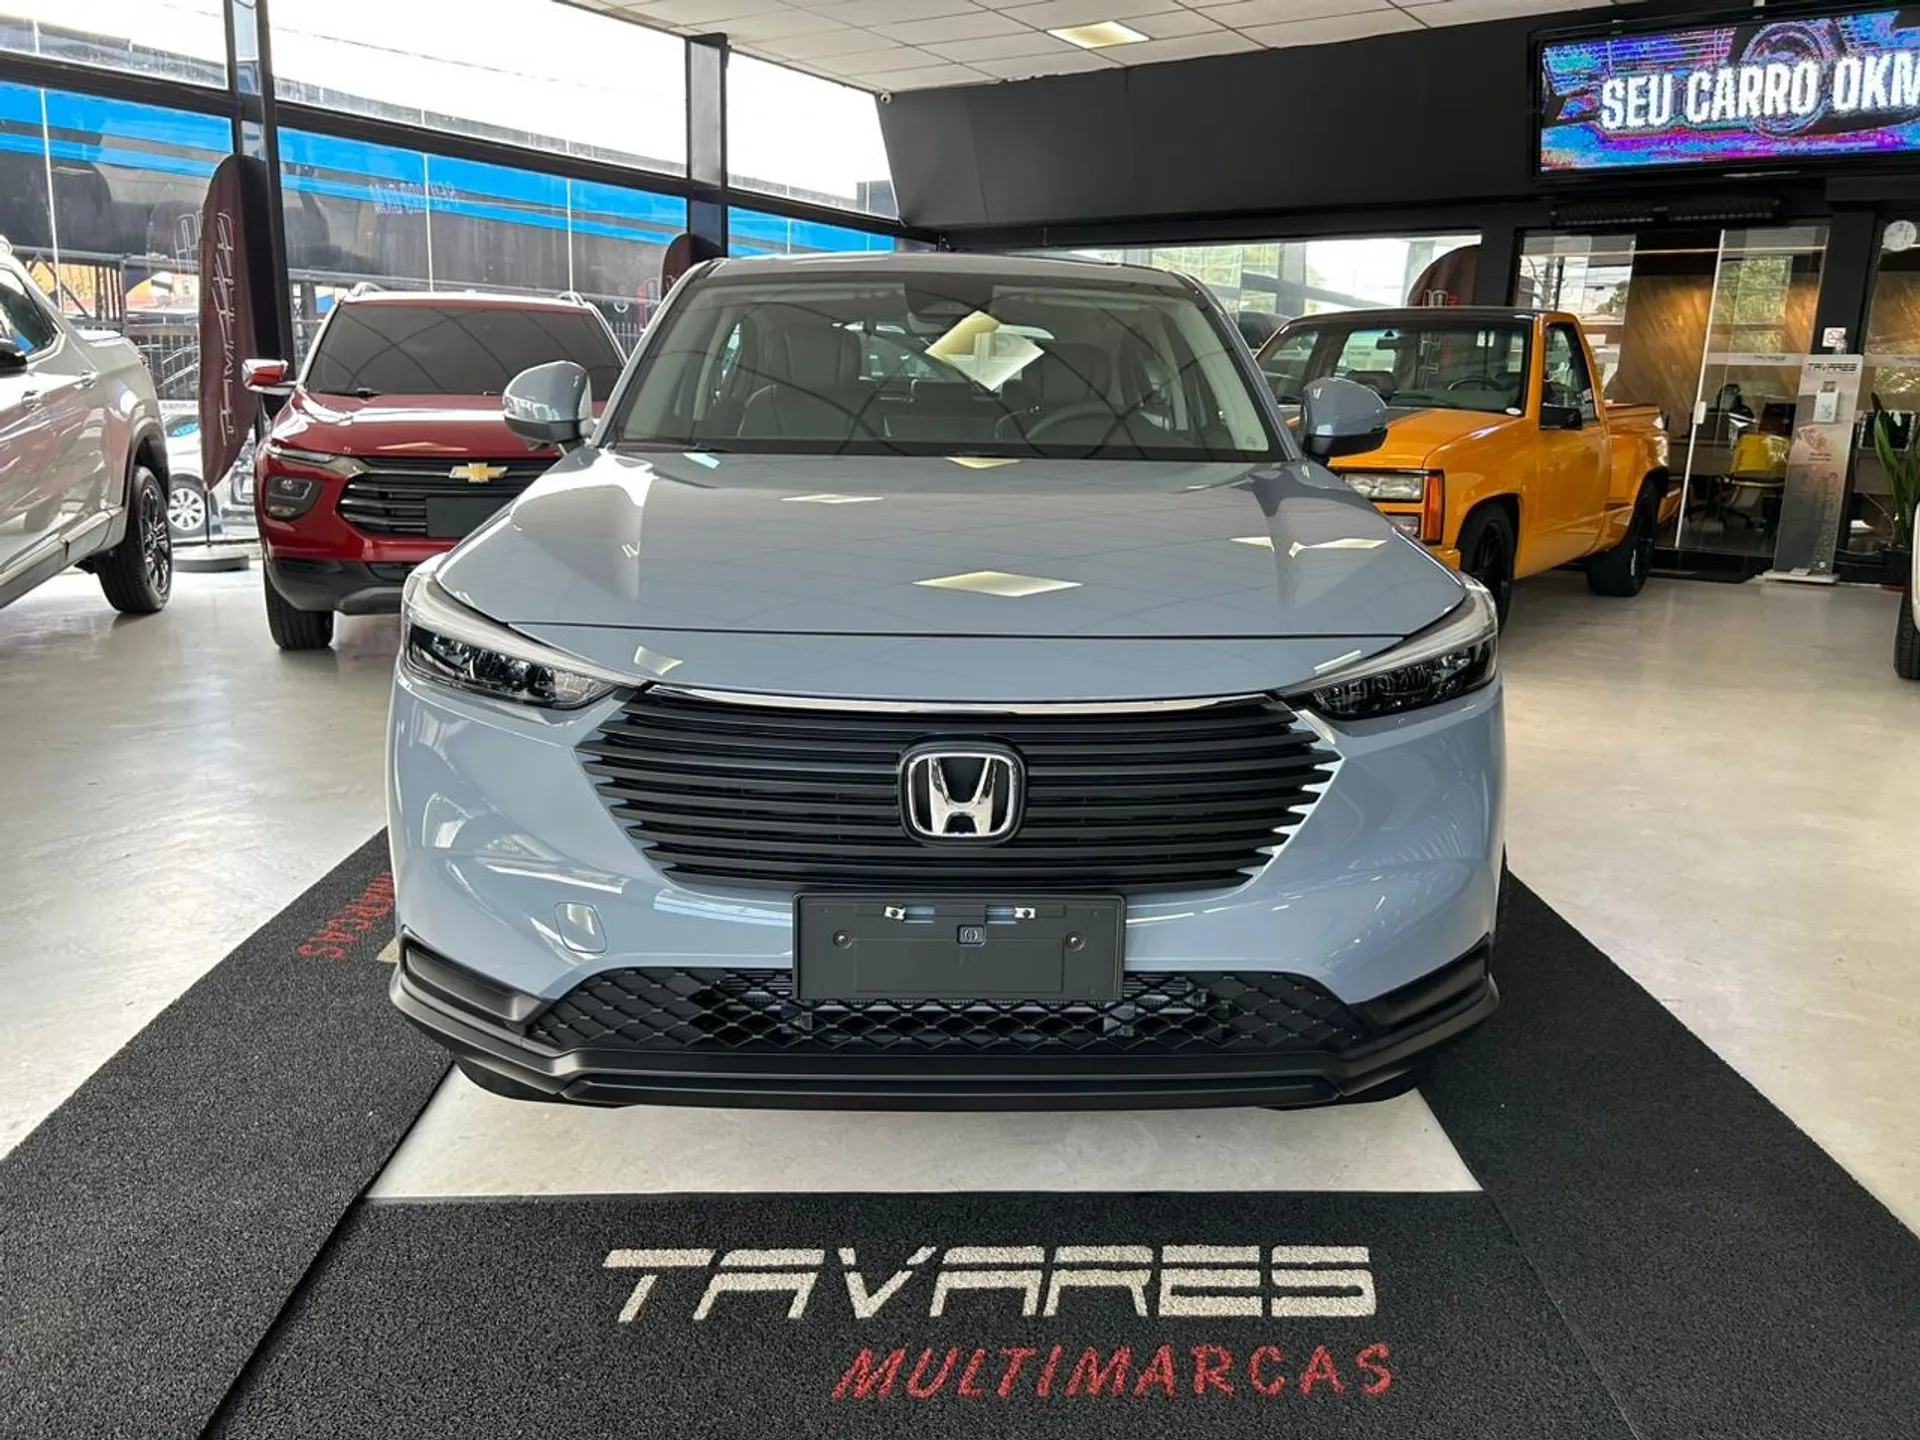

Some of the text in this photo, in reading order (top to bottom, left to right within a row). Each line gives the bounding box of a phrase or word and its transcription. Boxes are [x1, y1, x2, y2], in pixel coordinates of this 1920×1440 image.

[1600, 75, 1673, 130] SEU
[1687, 61, 1819, 123] CARRO
[602, 1244, 1377, 1323] TAVARES
[832, 1343, 1395, 1400] MULTIMARCAS
